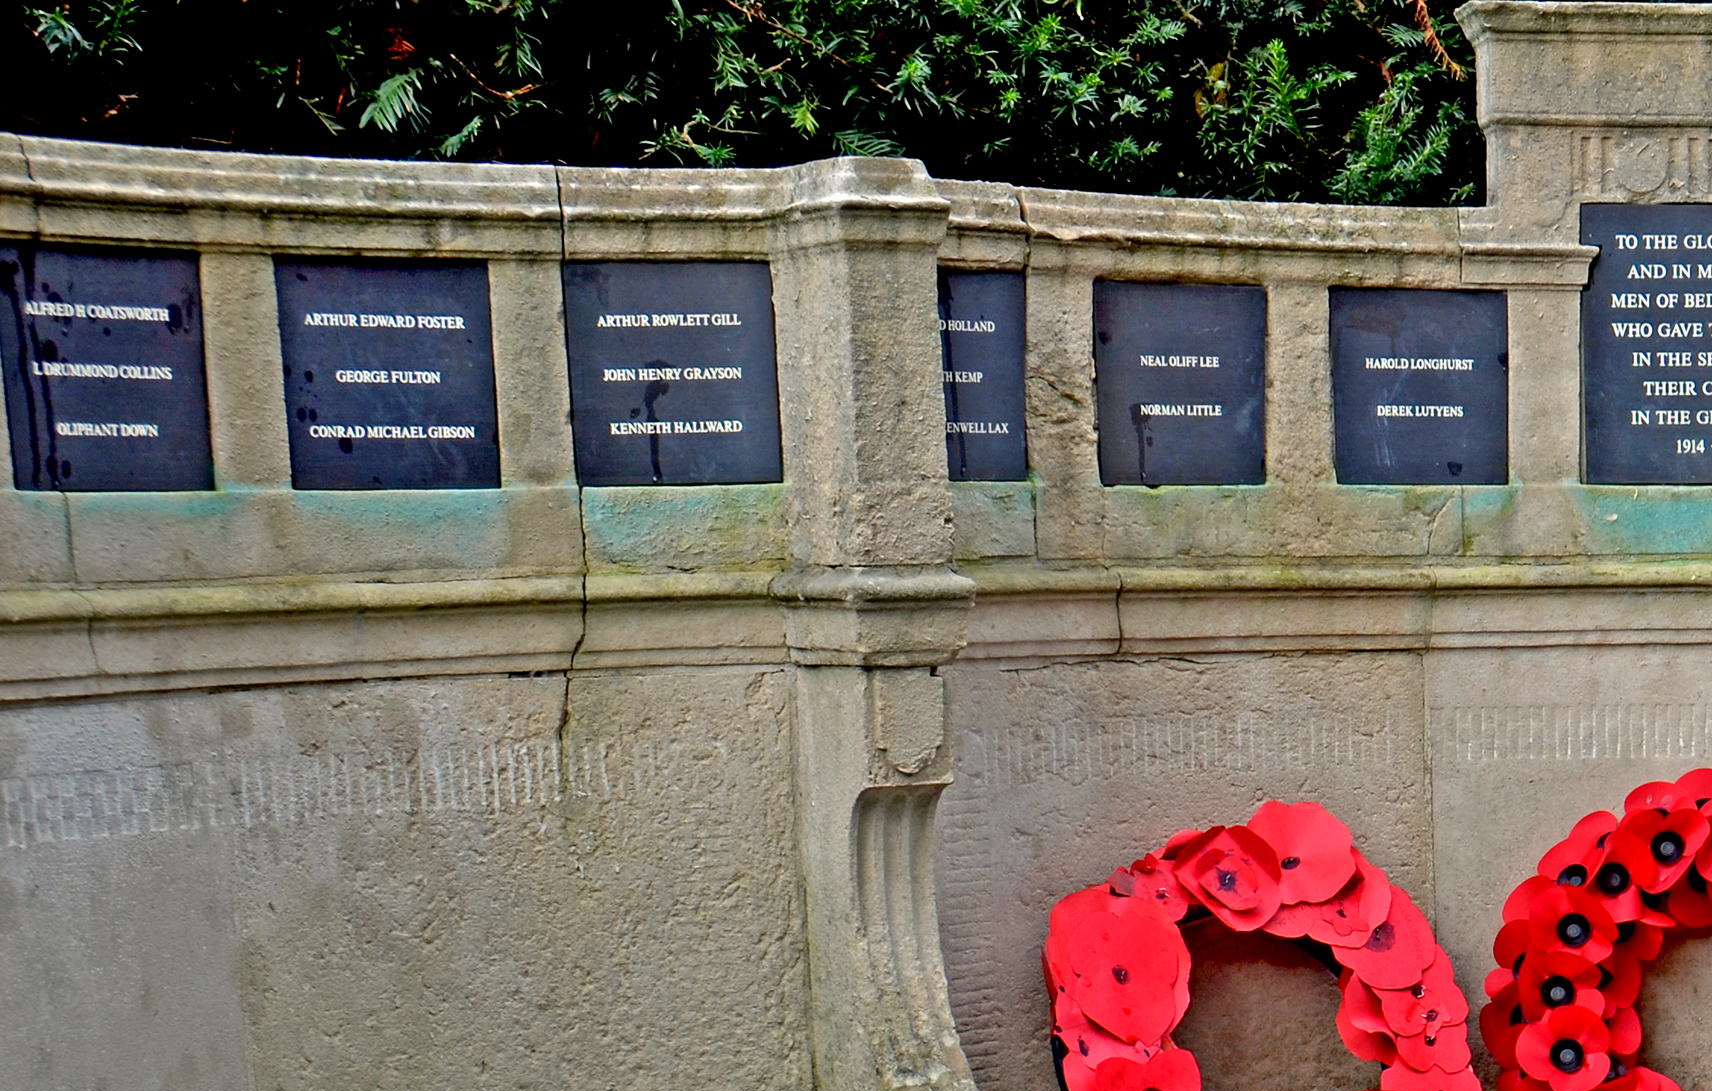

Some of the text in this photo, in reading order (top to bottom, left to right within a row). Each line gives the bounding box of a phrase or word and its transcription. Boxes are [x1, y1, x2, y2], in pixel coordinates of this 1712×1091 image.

[1615, 234, 1638, 250] TO
[1642, 234, 1678, 250] THE
[1627, 264, 1667, 279] AND
[1672, 264, 1691, 279] IN
[1611, 293, 1651, 309] MEN
[1655, 293, 1679, 309] OF
[24, 301, 170, 322] ALFRED H COATSWORTH
[304, 312, 466, 330] ARTHUR EDWARD FOSTER
[597, 313, 742, 328] ARTHUR ROWLETT GILL
[948, 320, 996, 333] HOLLAND
[1611, 322, 1653, 338] WHO
[1657, 322, 1704, 338] GAVE
[1140, 355, 1220, 368] NEAL OLIFF LEE
[1365, 357, 1475, 371] HAROLD LONGHURST
[1632, 352, 1651, 367] IN
[1656, 352, 1692, 367] THE
[32, 361, 173, 380] L DRUMMOND COLLINS
[335, 369, 441, 384] GEORGE FULTON
[603, 367, 742, 382] JOHN HENRY GRAYSON
[955, 371, 983, 383] KEMP
[1643, 381, 1697, 396] THEIR
[1140, 404, 1222, 417] NORMAN LITTLE
[1376, 405, 1464, 418] DEREK LUTYENS
[1631, 410, 1650, 425] IN
[1655, 410, 1691, 425] THE
[56, 422, 159, 438] OLIPHANT DOWN
[309, 425, 475, 439] CONRAD MICHAEL GIBSON
[610, 420, 743, 435] KENNETH HALLWARD
[988, 422, 1009, 434] LAX
[1676, 439, 1705, 454] 1914
